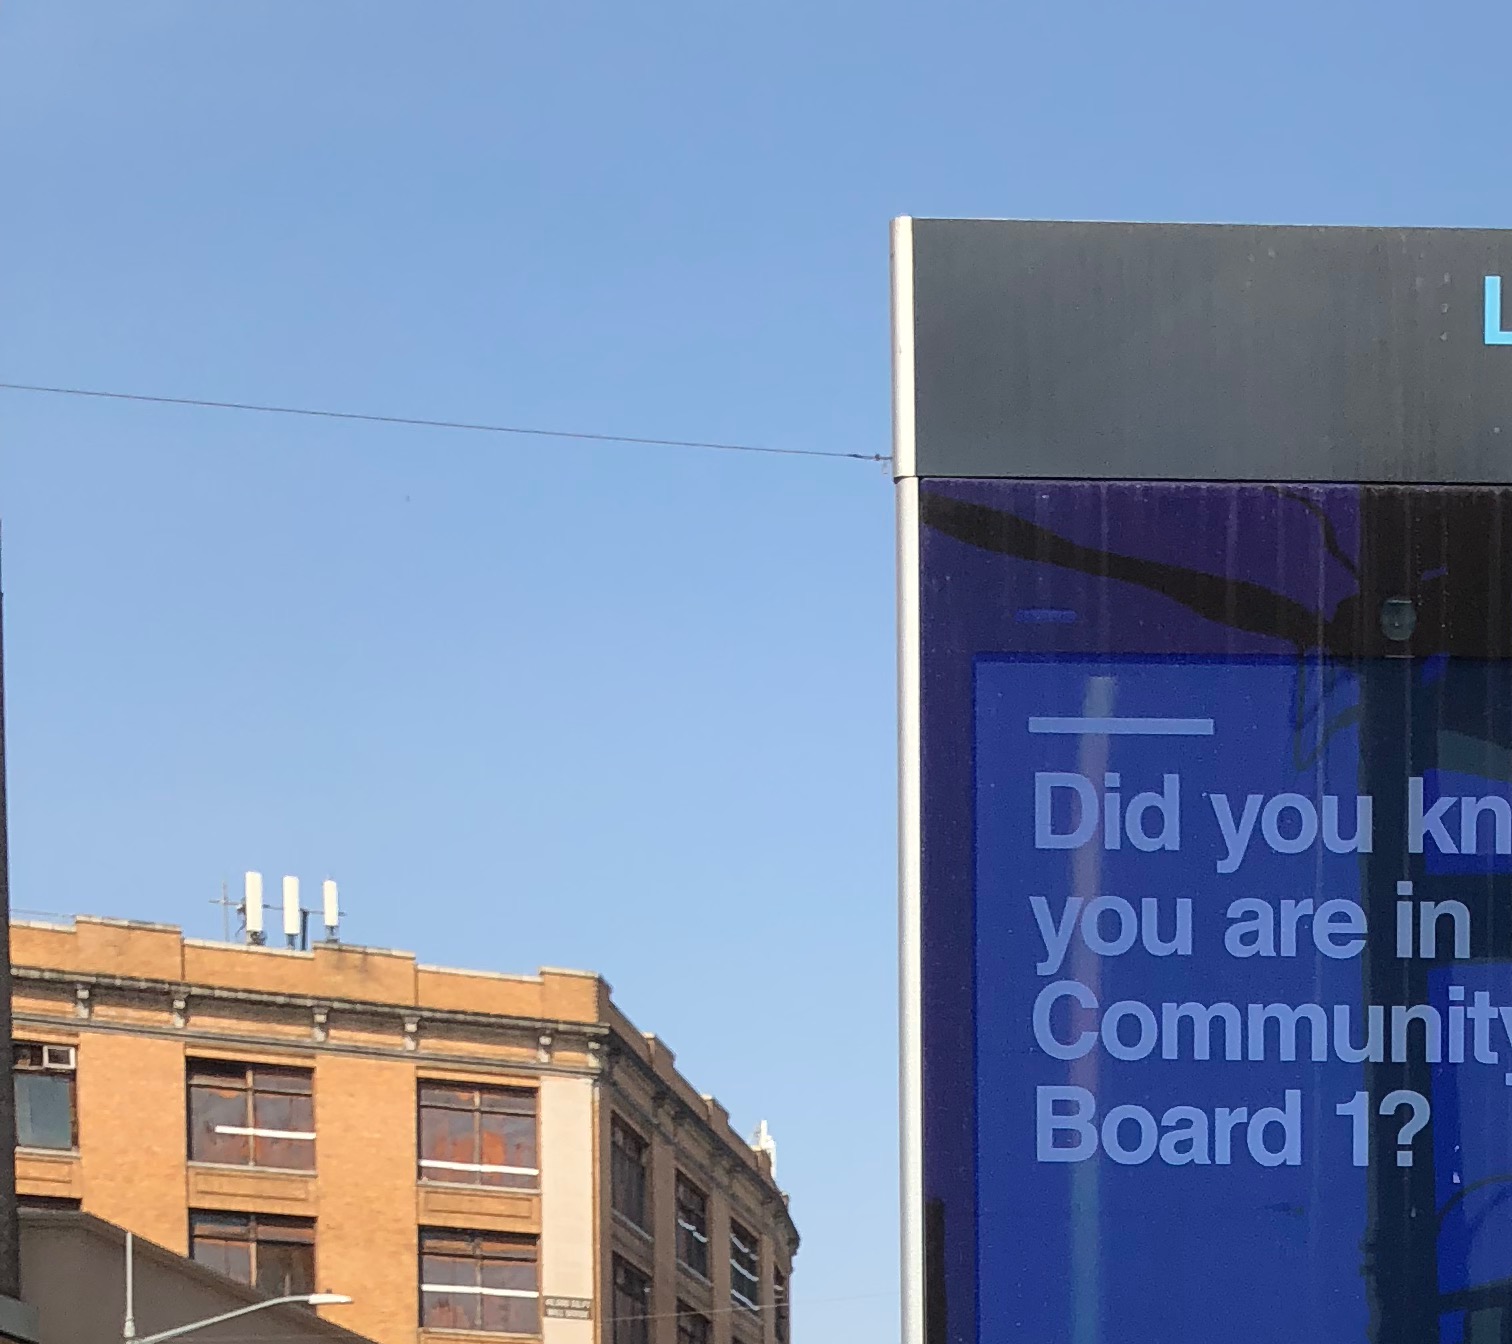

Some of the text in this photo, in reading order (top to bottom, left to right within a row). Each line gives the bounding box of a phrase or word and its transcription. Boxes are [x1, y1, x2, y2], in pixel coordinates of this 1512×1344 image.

[1034, 772, 1180, 851] Did
[1210, 794, 1373, 874] you
[1030, 881, 1471, 976] you are in
[1036, 1085, 1431, 1167] Board 1?
